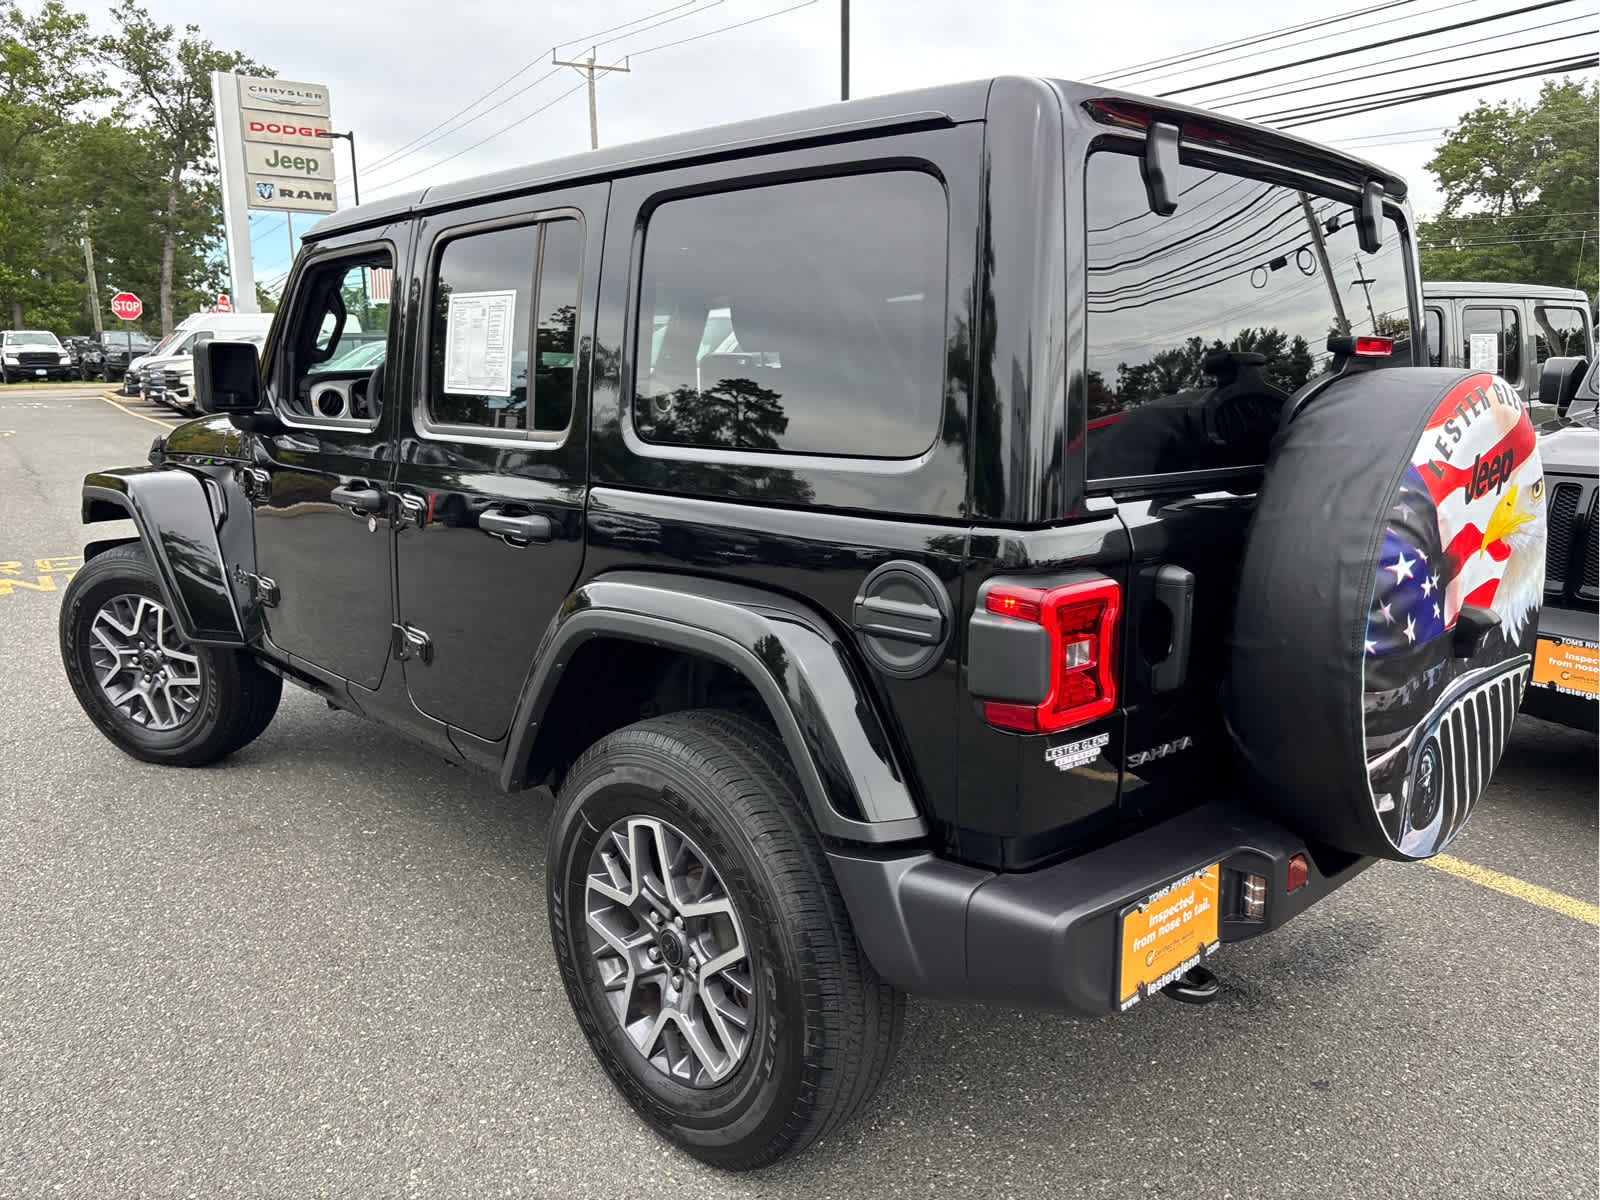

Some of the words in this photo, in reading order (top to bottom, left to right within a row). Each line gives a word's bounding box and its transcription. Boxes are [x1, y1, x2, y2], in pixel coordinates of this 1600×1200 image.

[248, 85, 322, 100] CHRYSLER
[265, 149, 320, 175] Jeep
[279, 188, 333, 201] RAM
[113, 301, 140, 312] STOP
[1426, 386, 1492, 481] LESTER
[1492, 382, 1525, 417] GLE
[1465, 448, 1514, 506] Jeep
[1548, 657, 1573, 669] from
[1045, 742, 1080, 761] LESTER
[1081, 733, 1109, 750] GLENN
[1127, 736, 1194, 769] SAHARA
[1149, 890, 1195, 928] Inspected
[1133, 933, 1156, 952] from
[1158, 916, 1181, 936] nose
[1182, 910, 1193, 922] to
[1194, 897, 1211, 915] tail.
[1147, 954, 1200, 996] lesterglenn
